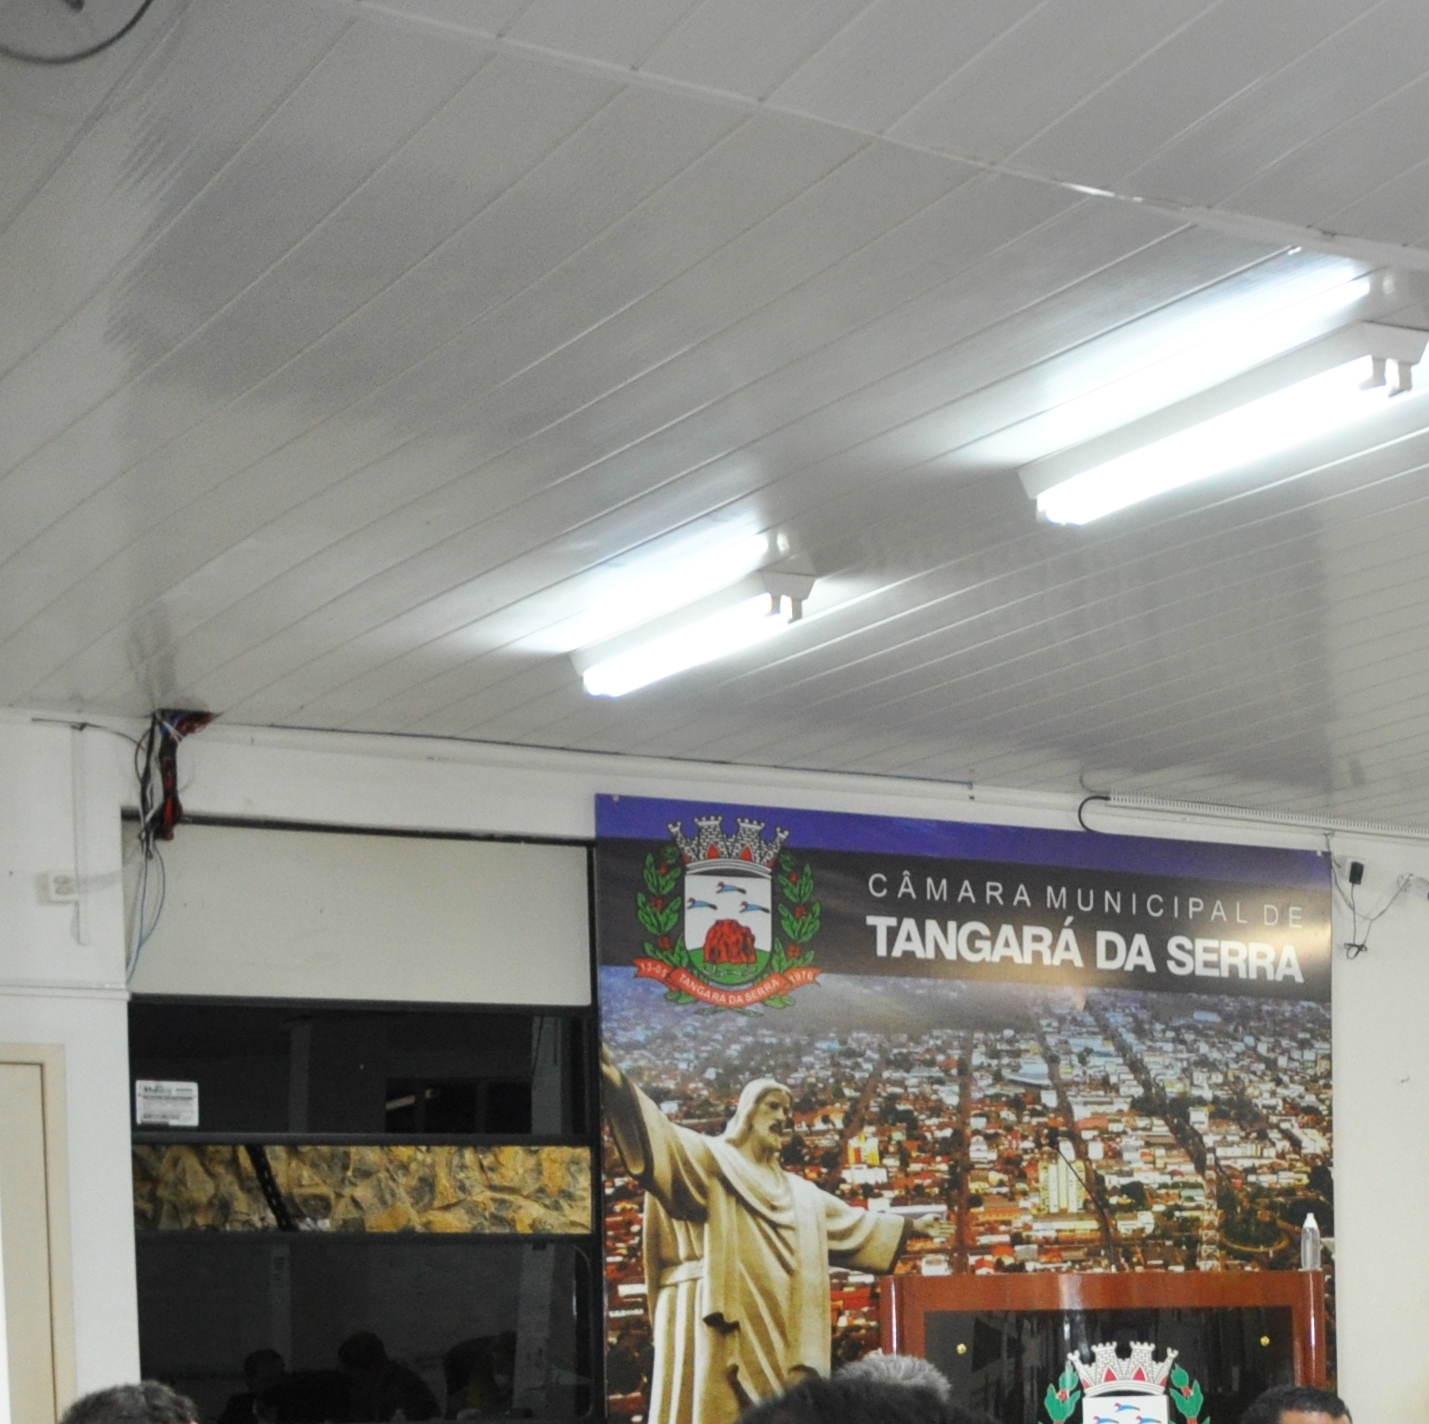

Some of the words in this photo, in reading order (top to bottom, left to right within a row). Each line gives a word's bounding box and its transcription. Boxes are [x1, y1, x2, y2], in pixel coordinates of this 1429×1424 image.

[867, 869, 1031, 909] CÂMARA
[1046, 885, 1251, 925] MUNICIPAL
[1262, 903, 1305, 928] DE
[867, 914, 1085, 968] TANGARÁ
[1096, 932, 1157, 973] DA
[1166, 936, 1305, 983] SERRA
[729, 993, 745, 1005] DA
[745, 978, 780, 1002] SERRA
[789, 970, 814, 984] 1976
